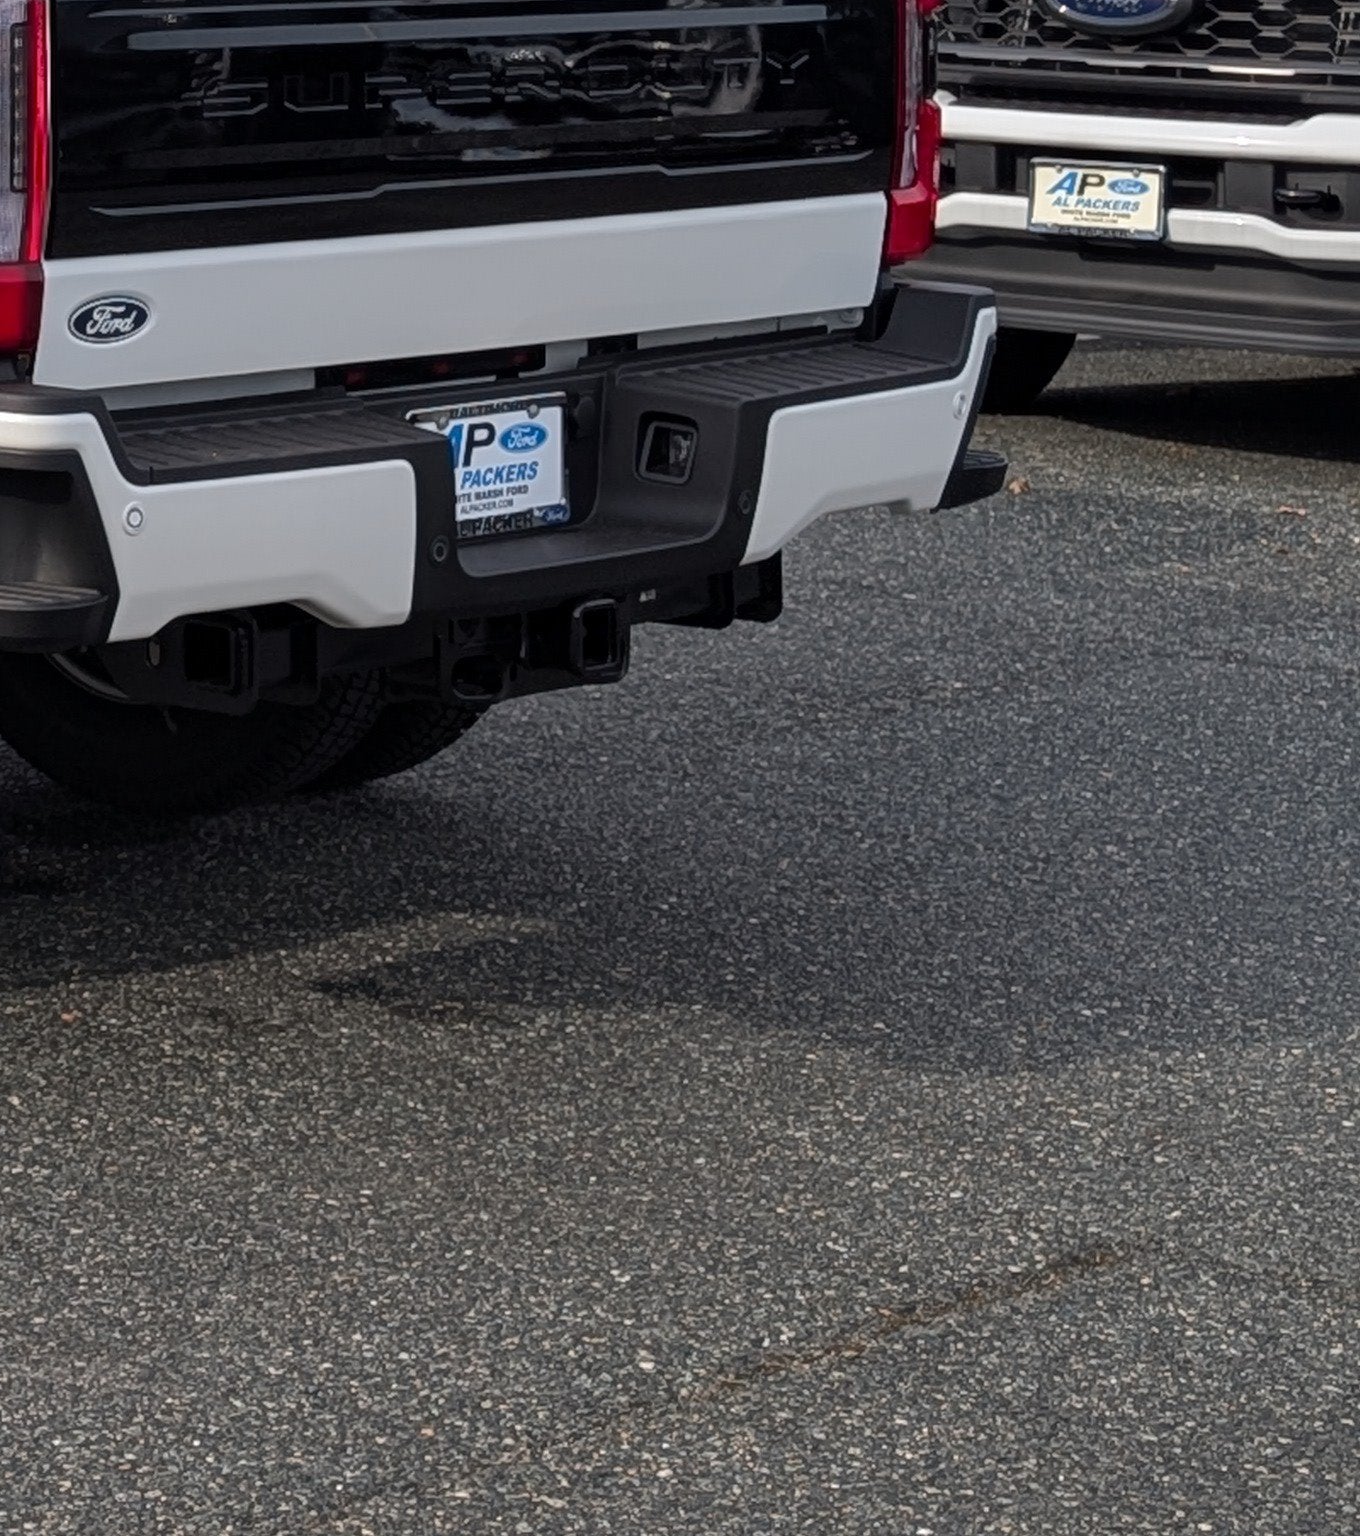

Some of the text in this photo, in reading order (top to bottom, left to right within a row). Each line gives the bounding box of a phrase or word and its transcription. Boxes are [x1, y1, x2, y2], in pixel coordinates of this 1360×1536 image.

[1046, 171, 1106, 196] AP
[1051, 197, 1141, 212] AL PACKERS
[86, 305, 138, 334] Ford
[460, 461, 539, 490] PACKERS
[506, 485, 529, 496] FORD
